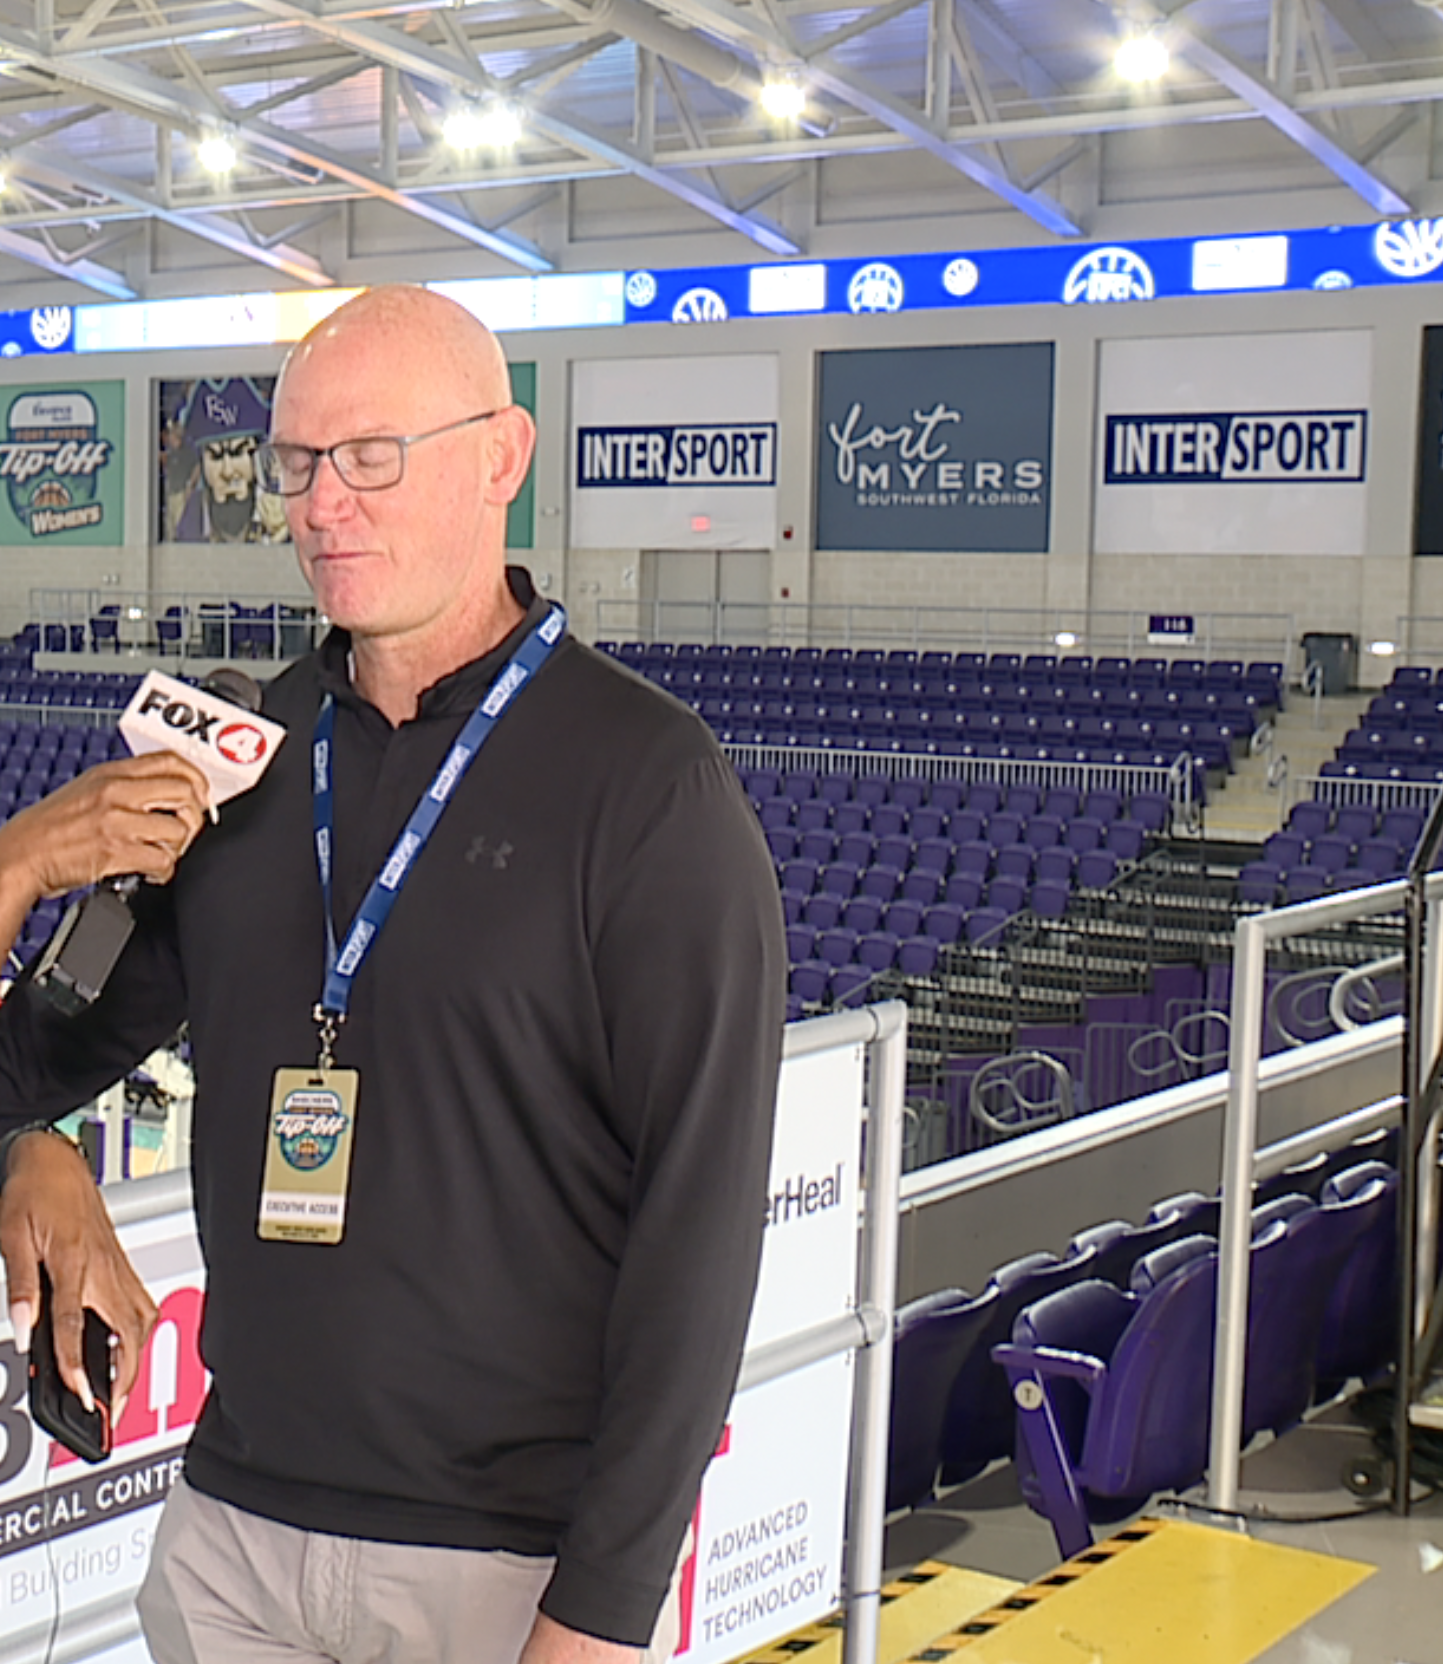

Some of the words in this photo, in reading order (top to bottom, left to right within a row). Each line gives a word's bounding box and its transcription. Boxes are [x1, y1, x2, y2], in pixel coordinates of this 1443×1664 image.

[583, 431, 768, 480] INTERSPORT
[858, 460, 1044, 491] MYERS
[1113, 420, 1355, 475] INTERSPORT
[858, 493, 959, 506] SOUTHWEST
[967, 492, 1041, 506] FLORIDA
[137, 688, 221, 746] FOX
[218, 727, 266, 763] 4
[708, 1500, 807, 1564] ADVANCED
[706, 1536, 808, 1604] HURRICANE
[703, 1564, 827, 1642] TECHNOLOGY
